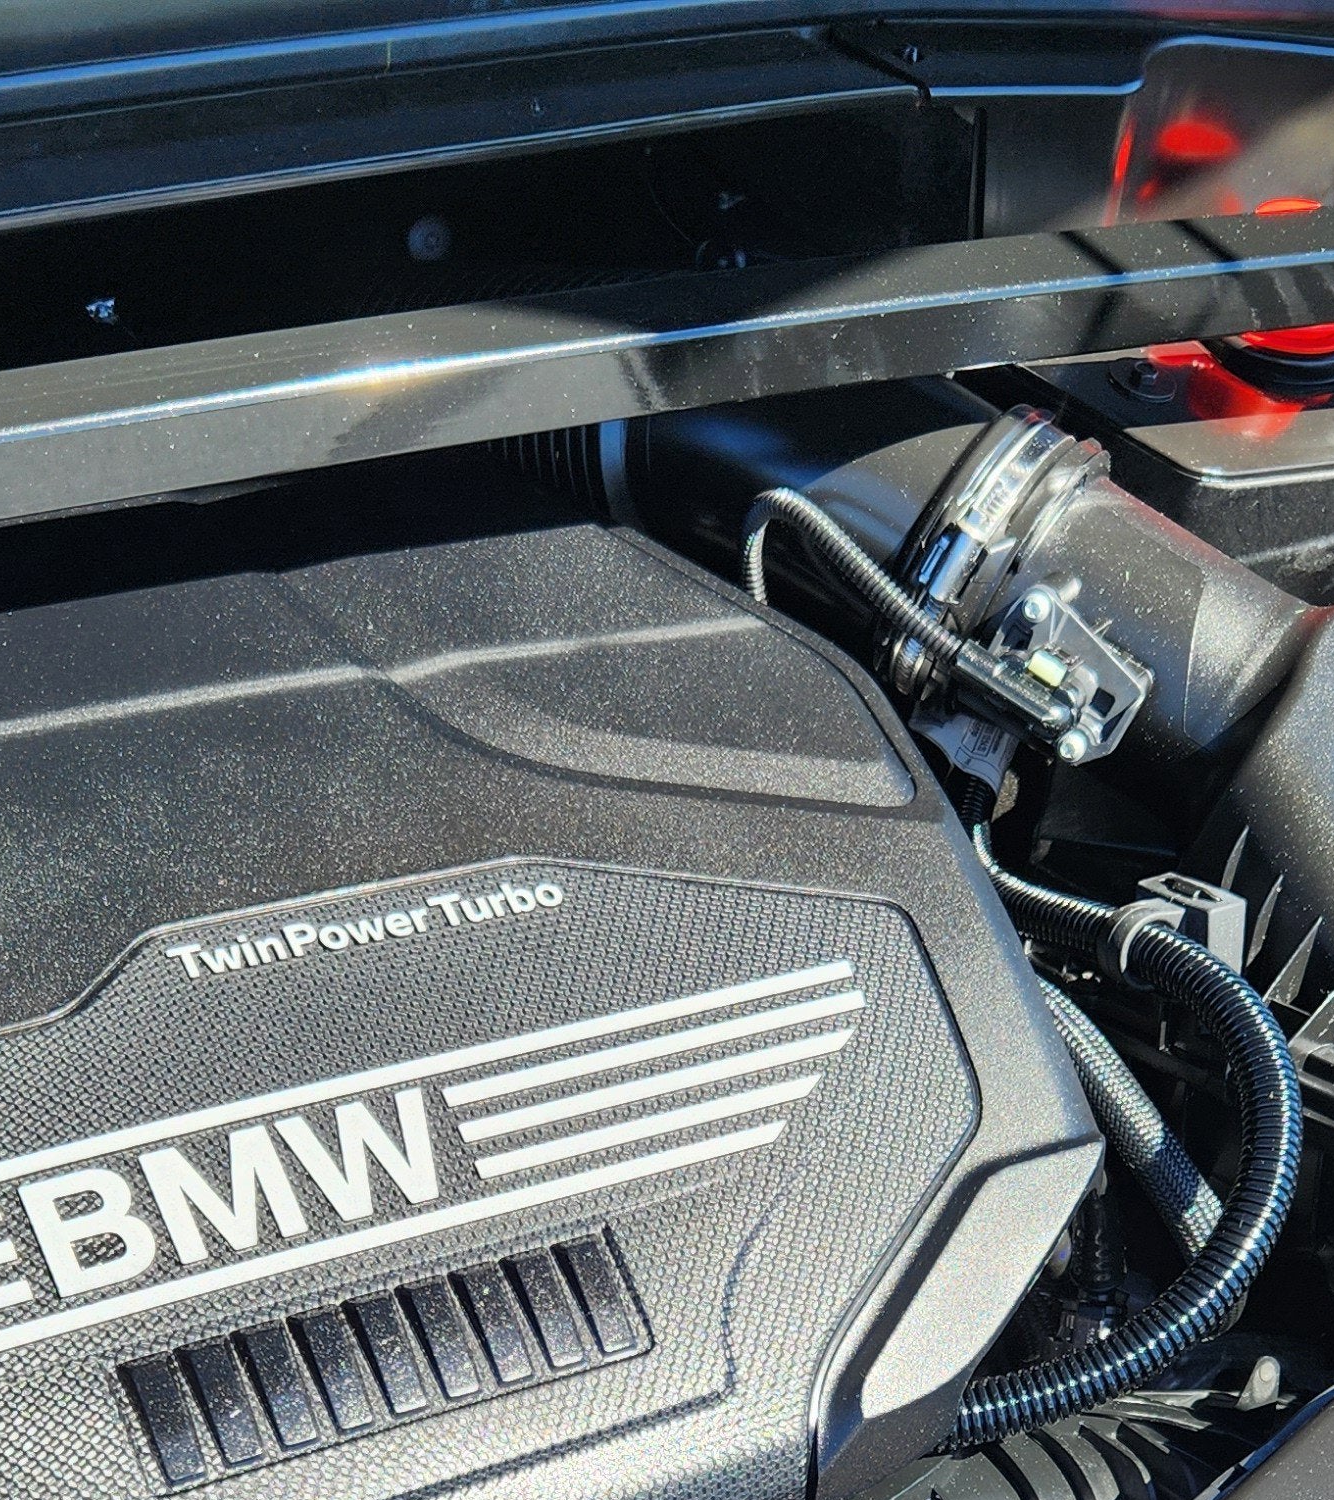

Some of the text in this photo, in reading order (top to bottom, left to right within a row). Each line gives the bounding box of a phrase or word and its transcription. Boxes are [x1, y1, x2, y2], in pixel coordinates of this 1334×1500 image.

[167, 882, 564, 979] TwinPower Turbo
[17, 1087, 440, 1298] BMW
